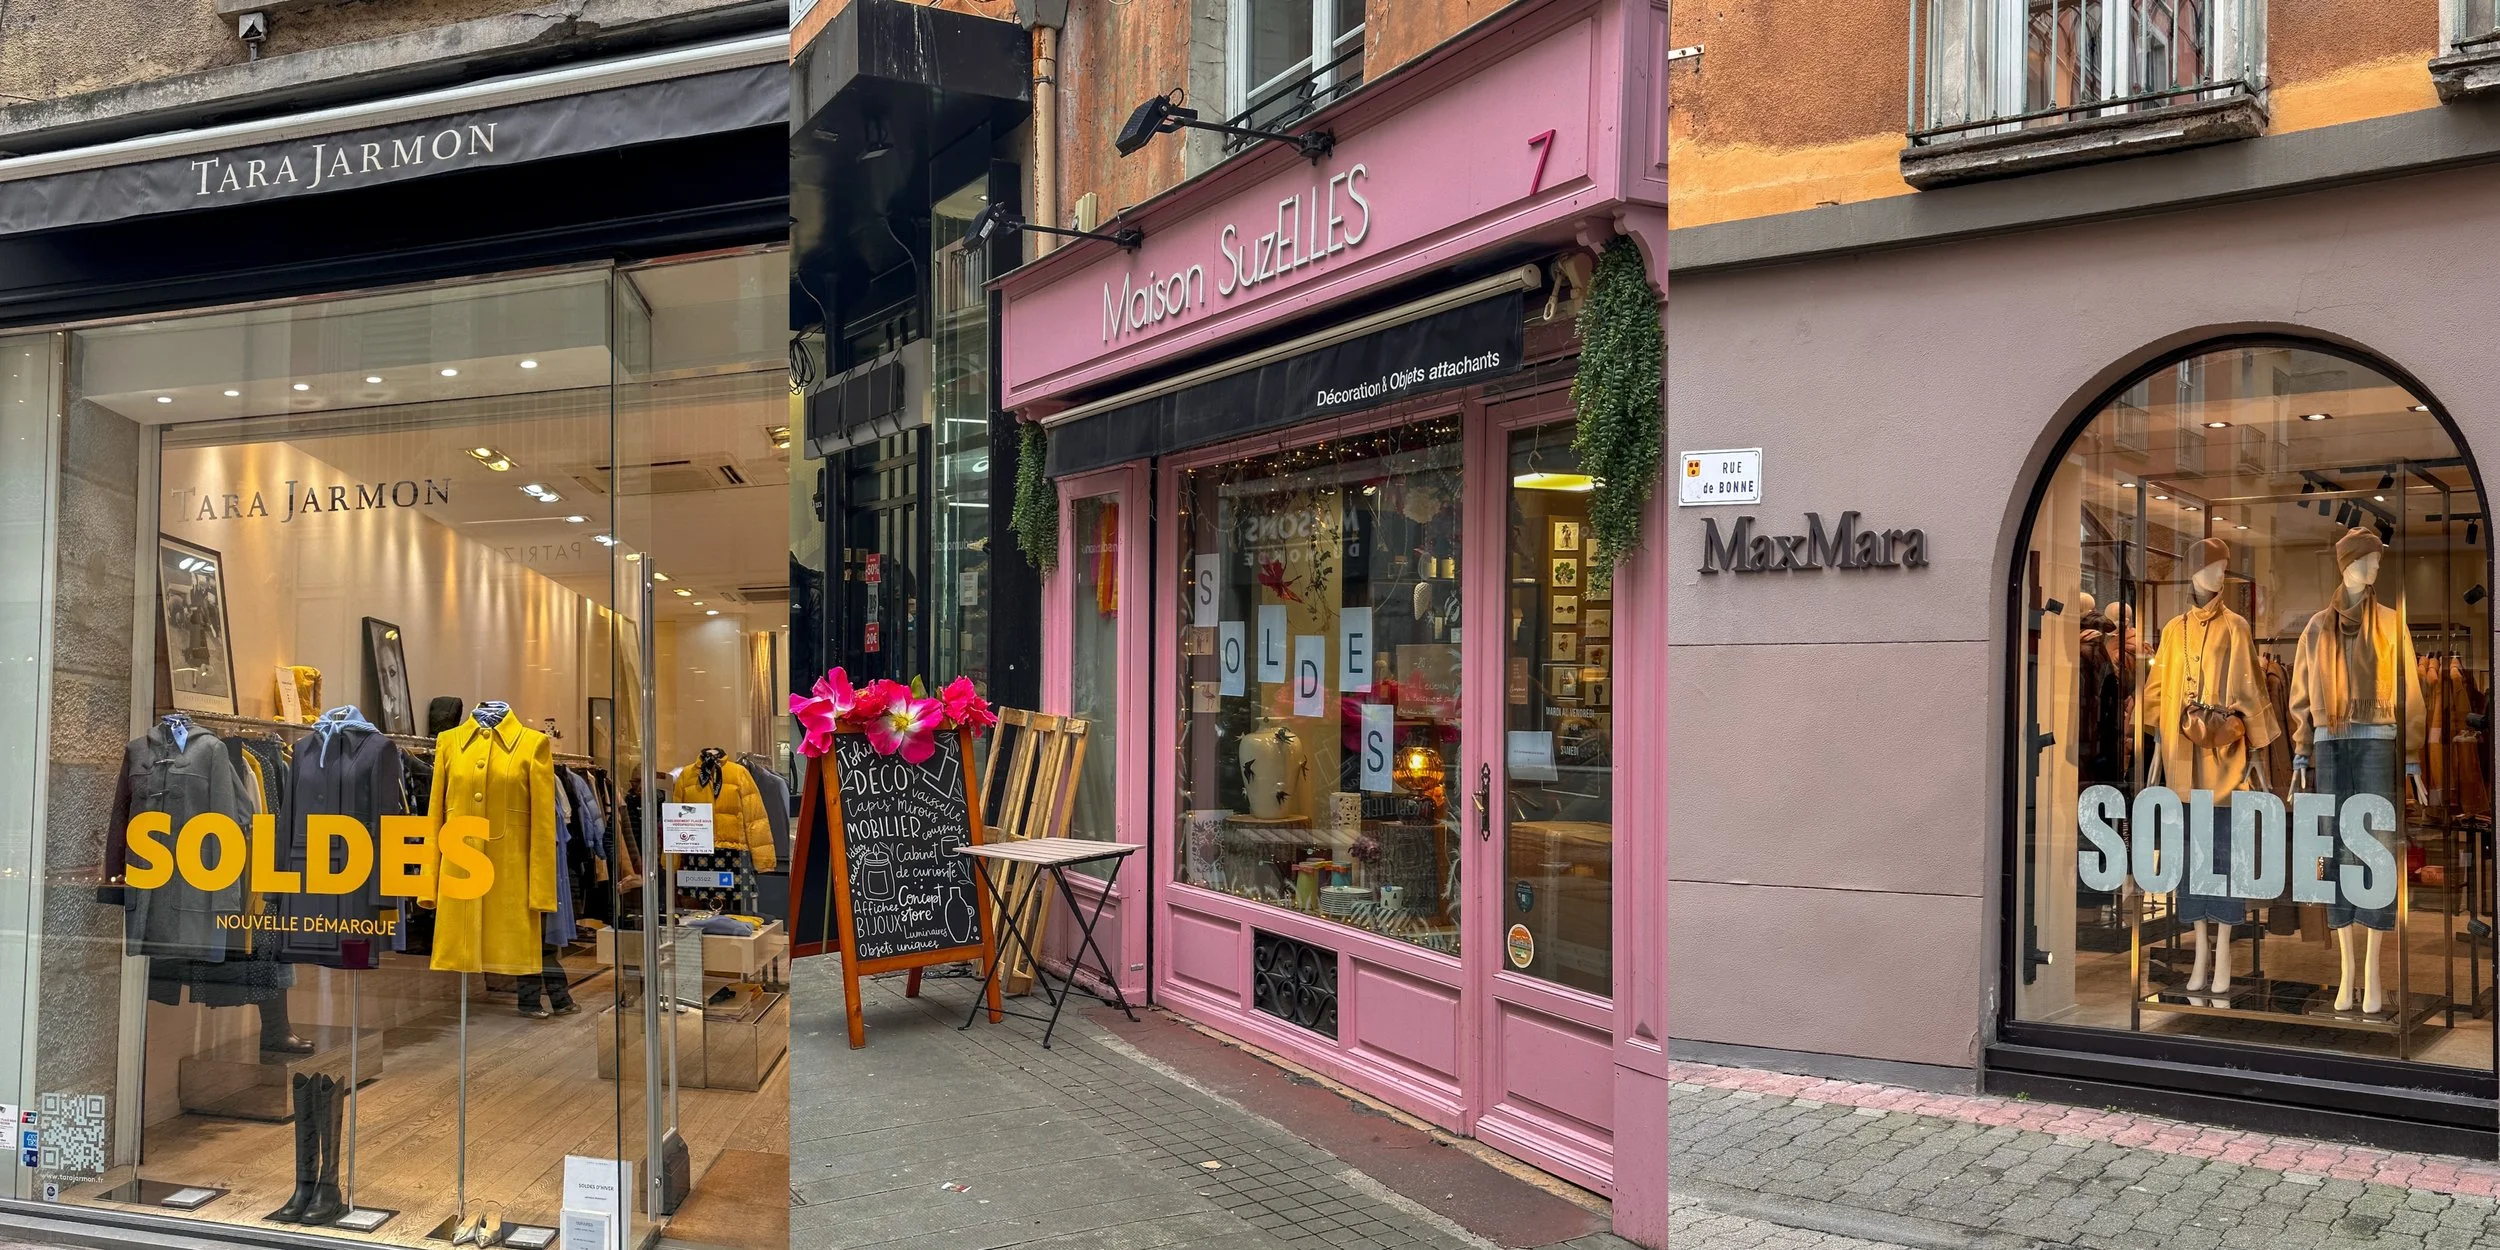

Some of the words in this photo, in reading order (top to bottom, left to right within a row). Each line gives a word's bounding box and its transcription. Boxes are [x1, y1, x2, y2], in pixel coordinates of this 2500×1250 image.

[191, 155, 298, 196] TARA
[306, 122, 498, 190] JARMON
[1527, 129, 1556, 196] 7
[1102, 262, 1206, 344] Maison
[1218, 162, 1371, 297] SuzELLES
[1316, 381, 1381, 407] Décoration
[1382, 375, 1388, 393] &
[1389, 366, 1425, 391] Objets
[1428, 350, 1500, 381] attachants
[1722, 461, 1742, 474] RUE
[170, 486, 268, 524] TARA
[280, 477, 453, 524] JARMON
[1703, 481, 1714, 494] de
[1718, 480, 1754, 493] BONNE
[1697, 510, 1930, 574] MaxMara
[854, 758, 909, 796] DÉCO
[845, 797, 892, 819] tapis
[911, 788, 962, 822] vaisselle
[847, 814, 921, 843] MOBILIER
[922, 824, 964, 841] coussins
[125, 811, 495, 900] SOLDES
[895, 841, 938, 865] Cabinet
[2077, 784, 2398, 910] SOLDES
[895, 866, 910, 879] de
[912, 860, 958, 883] curiosité
[854, 899, 900, 917] Affiches
[898, 883, 944, 911] Concept
[216, 913, 299, 932] NOUVELLE
[304, 913, 398, 937] DÉMARQUE
[856, 913, 903, 939] BIJOUX
[900, 906, 934, 928] store
[859, 940, 894, 958] Objets
[896, 938, 940, 954] uniques
